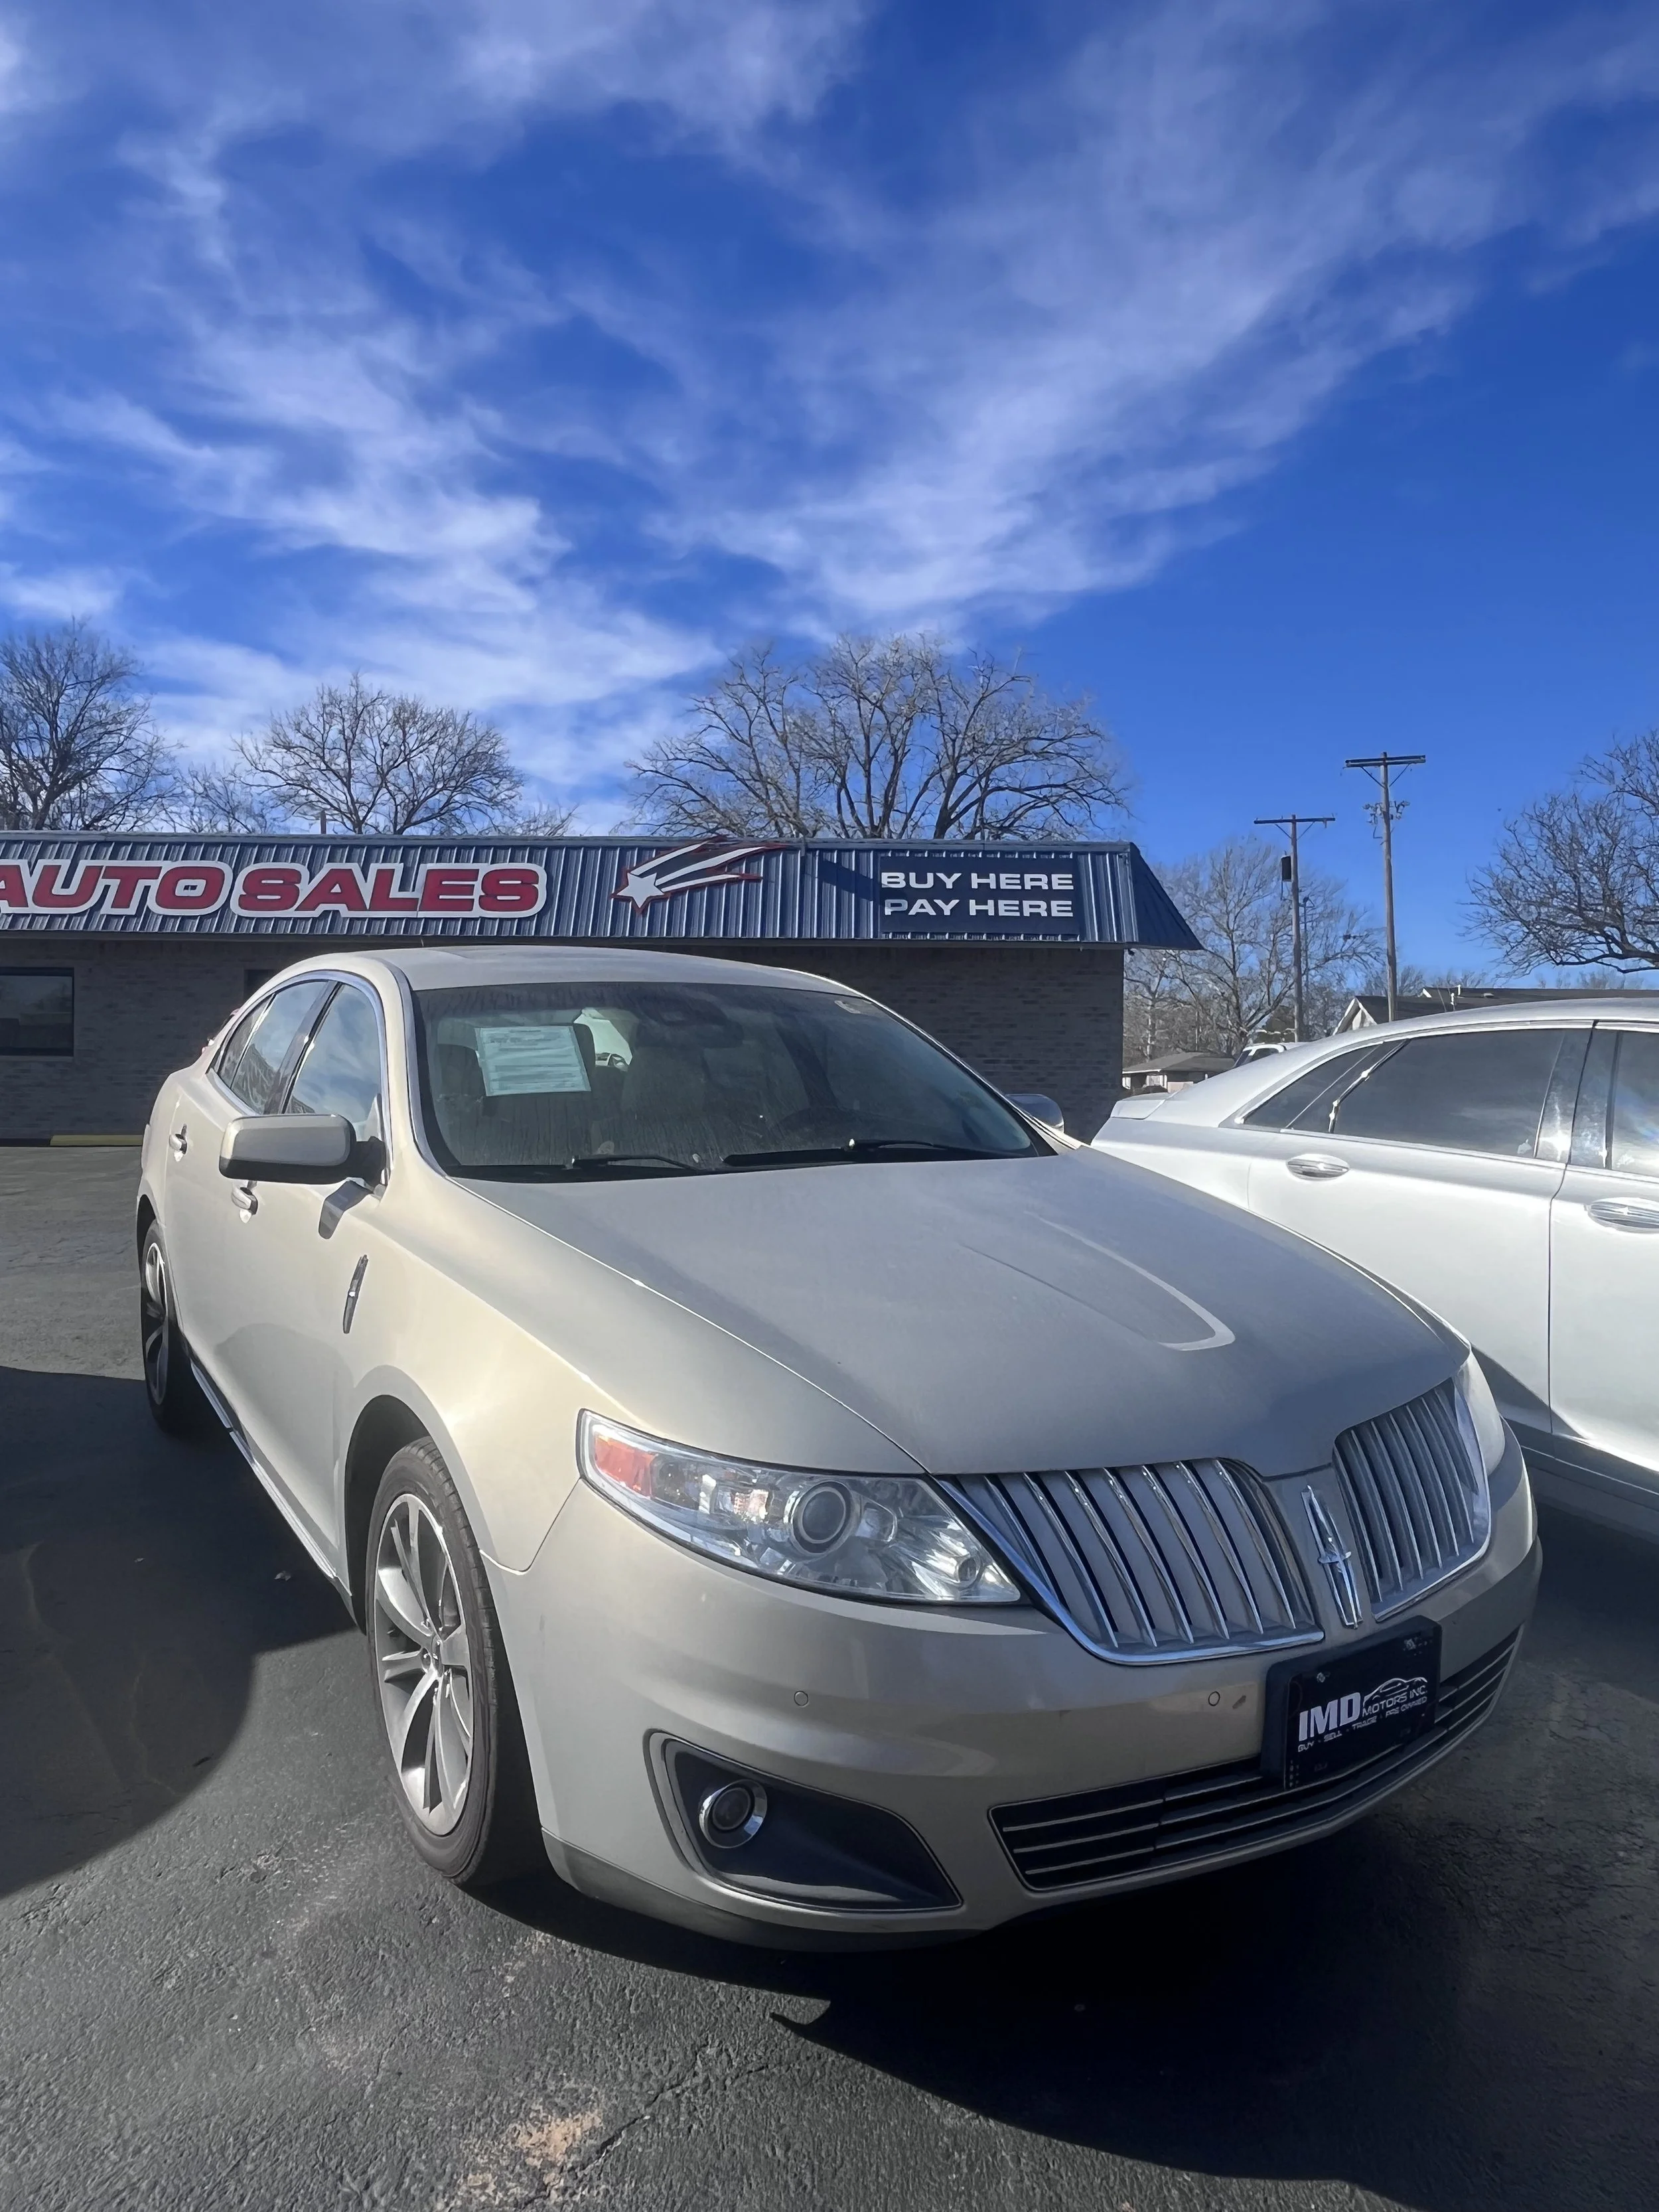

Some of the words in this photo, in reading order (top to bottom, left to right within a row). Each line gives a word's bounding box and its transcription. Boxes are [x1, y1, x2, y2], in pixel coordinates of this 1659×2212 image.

[236, 865, 543, 915] SALES
[881, 871, 962, 889] BUY
[970, 872, 1074, 891] HERE
[884, 899, 960, 916] PAY
[968, 899, 1074, 917] HERE
[1299, 1692, 1361, 1742] IMD
[1362, 1692, 1407, 1718] MOTORS
